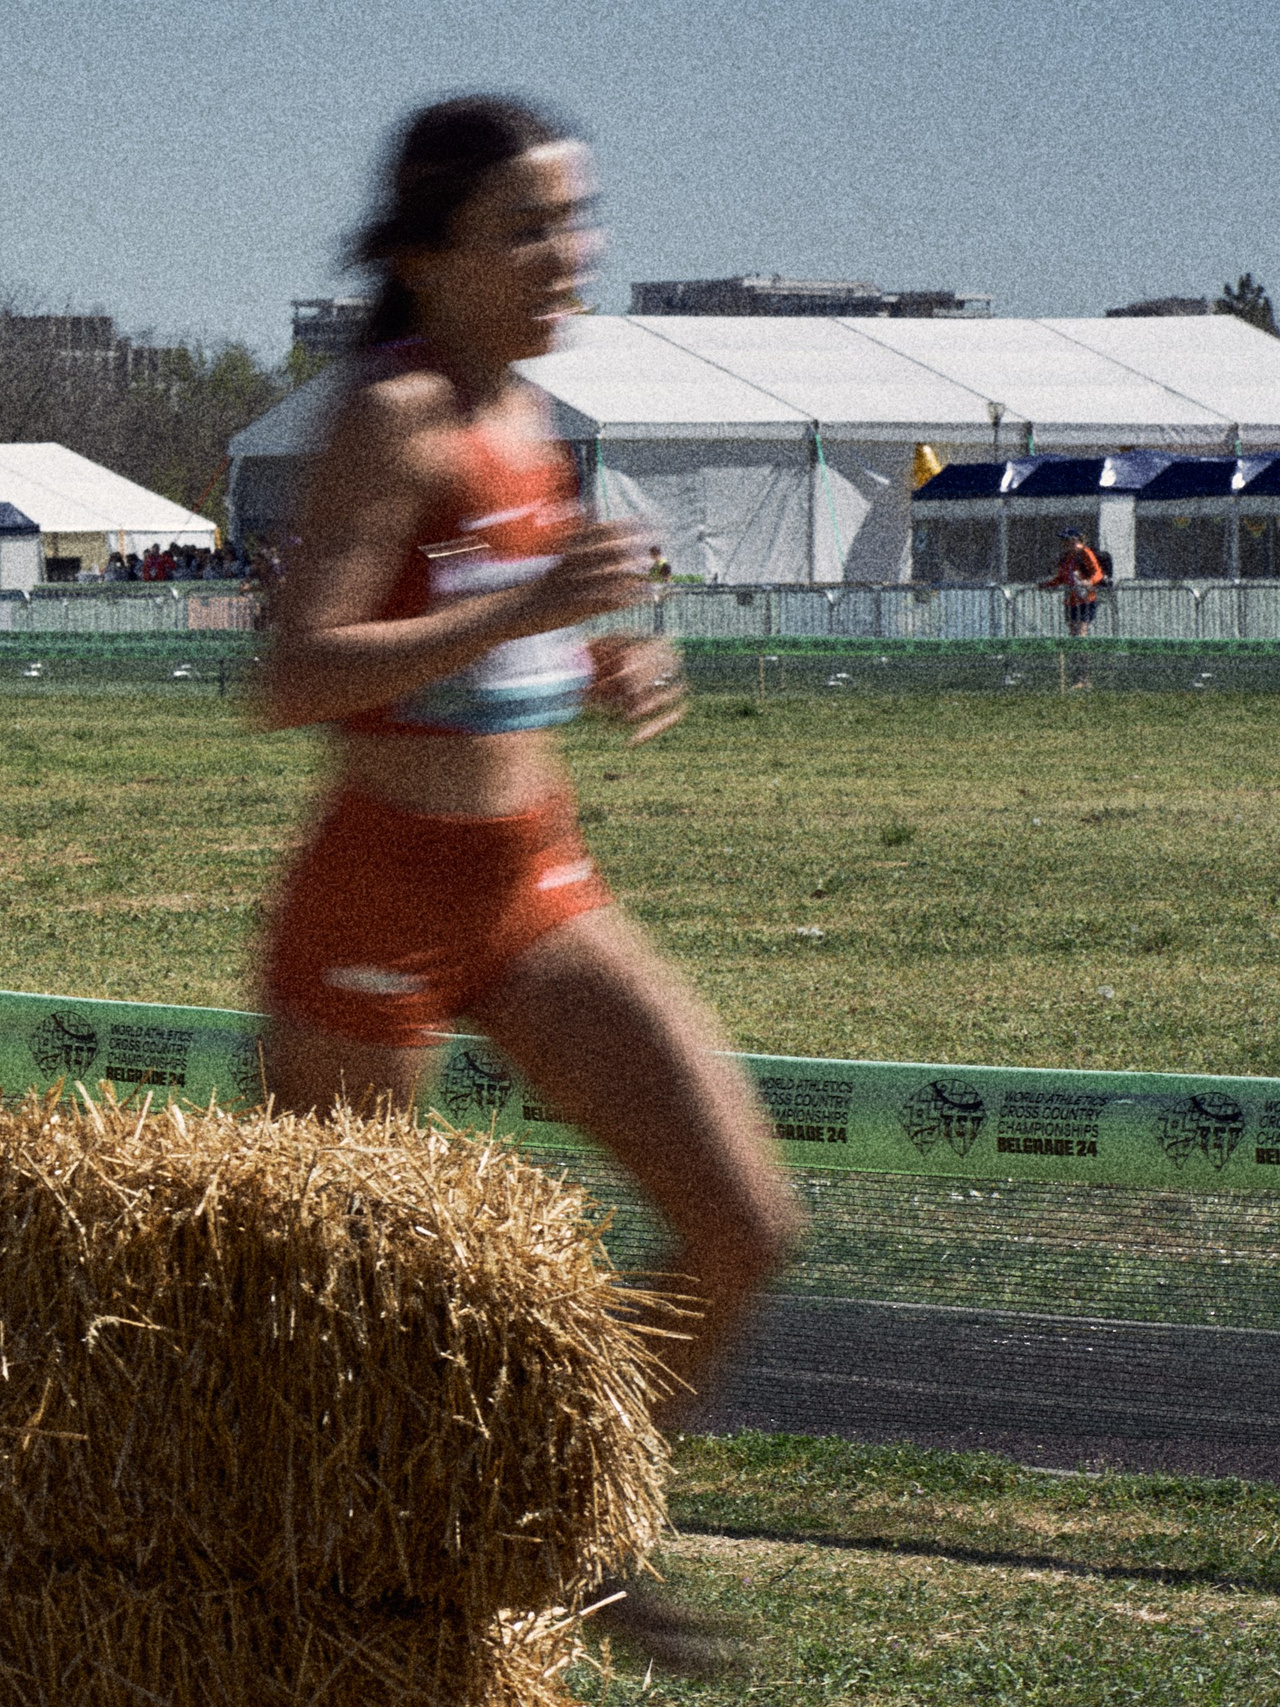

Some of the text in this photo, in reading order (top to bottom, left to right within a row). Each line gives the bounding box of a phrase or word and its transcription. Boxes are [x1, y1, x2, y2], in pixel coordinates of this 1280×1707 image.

[110, 1024, 194, 1042] WORLD ATHLETICS
[109, 1037, 189, 1055] CROSS COUNTRY
[108, 1052, 187, 1071] CHAMPIONSHIPS
[106, 1066, 186, 1088] BELGRADE 24
[758, 1077, 854, 1093] WORLD ATHLETICS
[794, 1094, 852, 1108] COUNTRY
[1004, 1091, 1107, 1107] WORLD ATHLETICS
[763, 1108, 849, 1125] AMPIONSHIPS
[1000, 1105, 1104, 1121] CROSS COUNTRY
[762, 1123, 847, 1144] LGRADE 24
[997, 1120, 1099, 1138] CHAMPIONSHIPS
[996, 1136, 1098, 1157] BELGRADE 24
